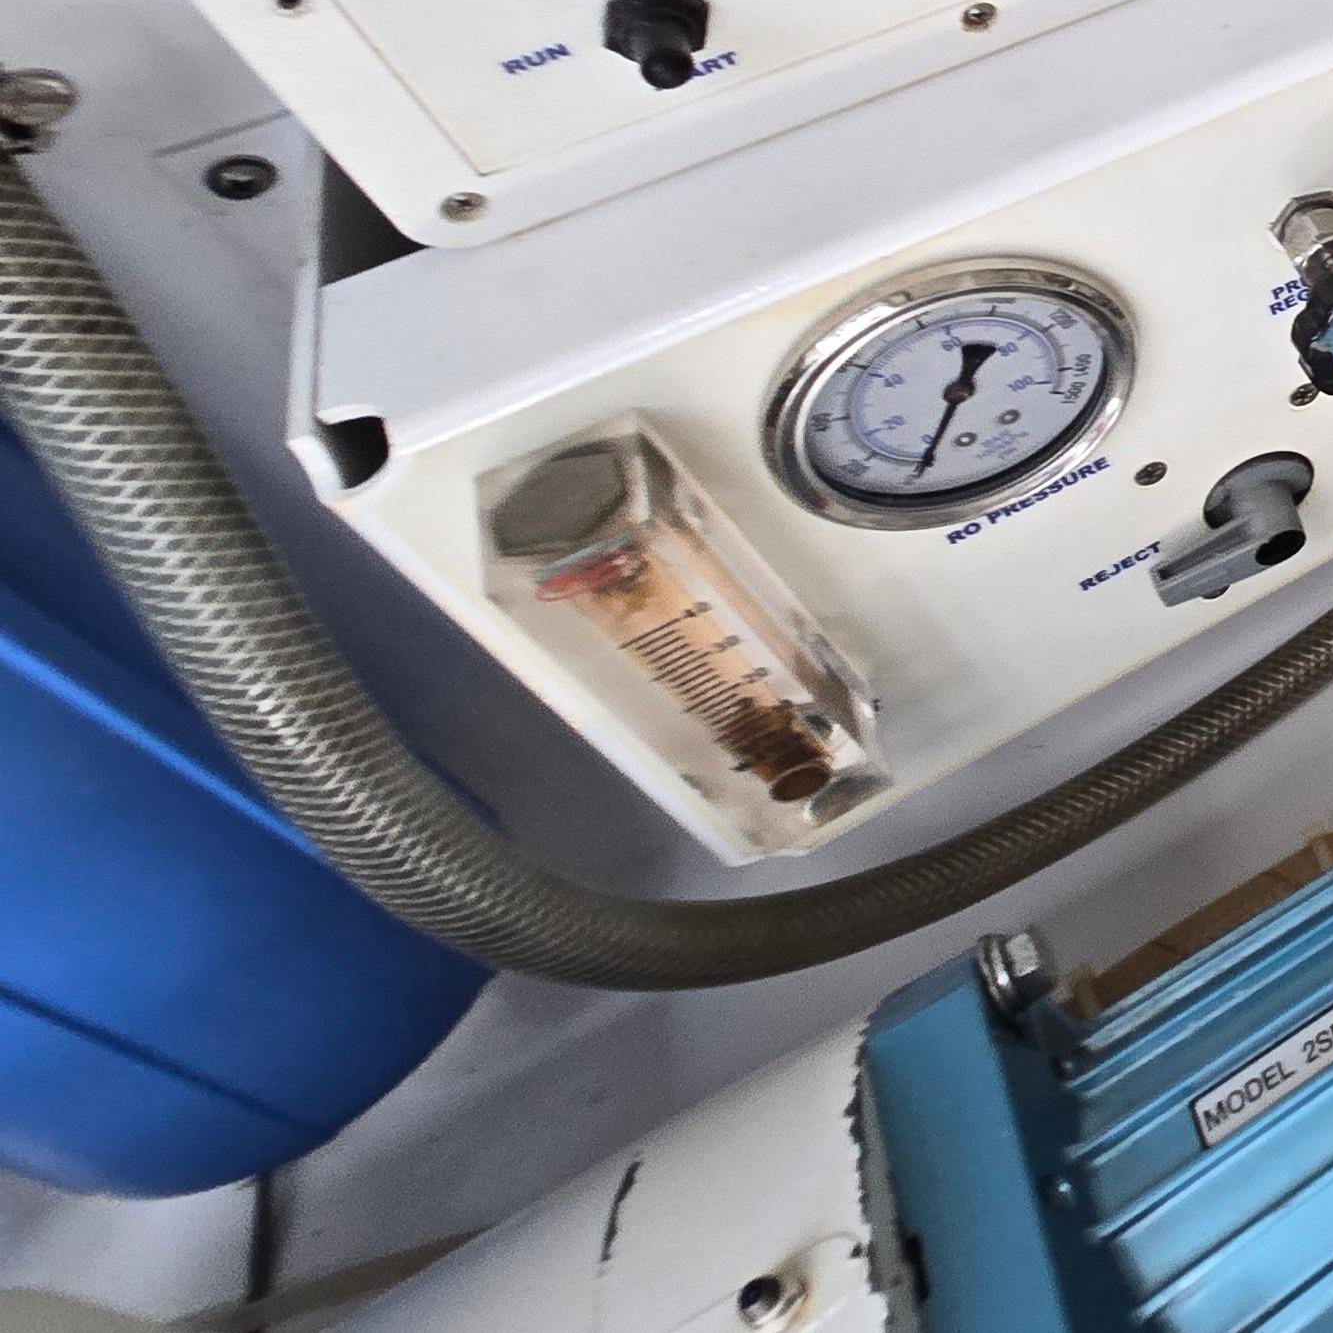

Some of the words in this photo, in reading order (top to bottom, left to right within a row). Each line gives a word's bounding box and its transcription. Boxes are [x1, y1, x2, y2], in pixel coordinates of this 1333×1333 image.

[502, 42, 573, 75] RUN
[946, 521, 982, 545] RO
[985, 456, 1112, 525] PRESSURE
[1078, 540, 1160, 592] REJECT
[1202, 1060, 1297, 1133] MODEL
